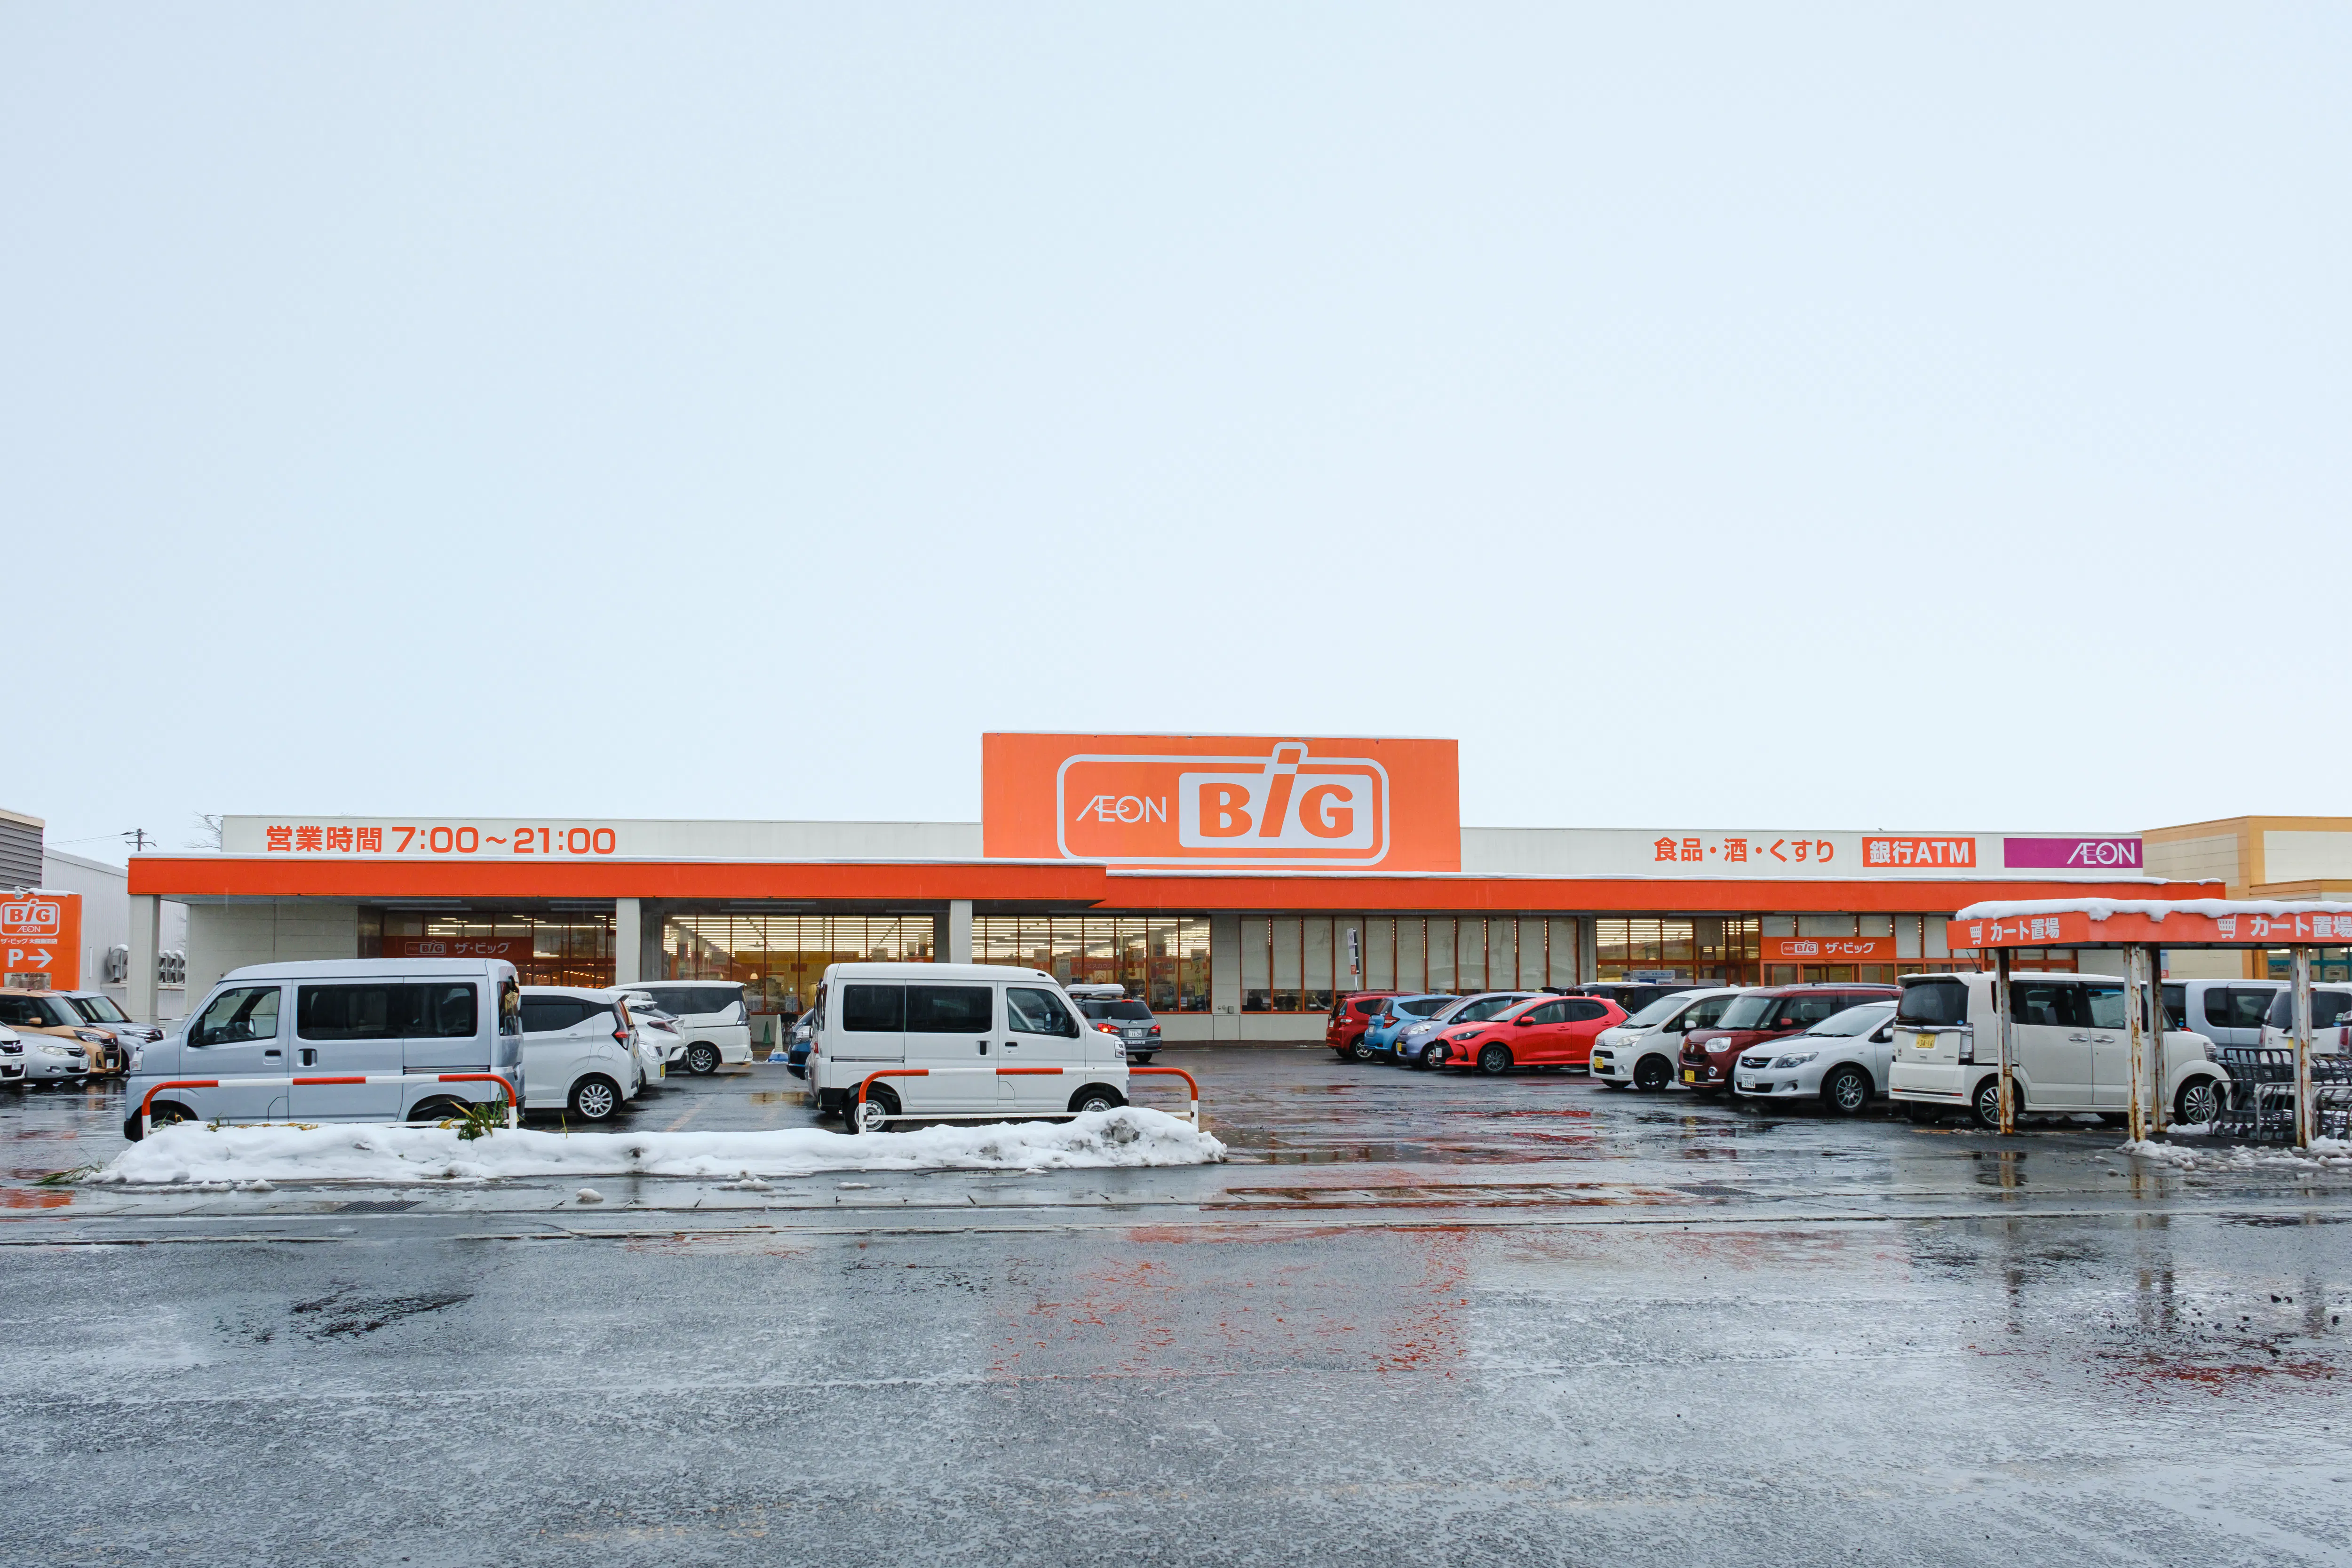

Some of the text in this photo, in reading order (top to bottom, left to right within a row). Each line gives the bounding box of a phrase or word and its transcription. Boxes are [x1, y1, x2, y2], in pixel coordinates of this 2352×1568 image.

[266, 825, 382, 852] 営業時間
[1653, 837, 1834, 863] 食品・酒・くすり
[1869, 840, 1970, 864] 銀行ATM
[1990, 917, 2060, 941] カート置場
[2250, 915, 2352, 938] カート置場
[8, 948, 24, 967] P
[1825, 942, 1875, 953] ザ・ビッグ
